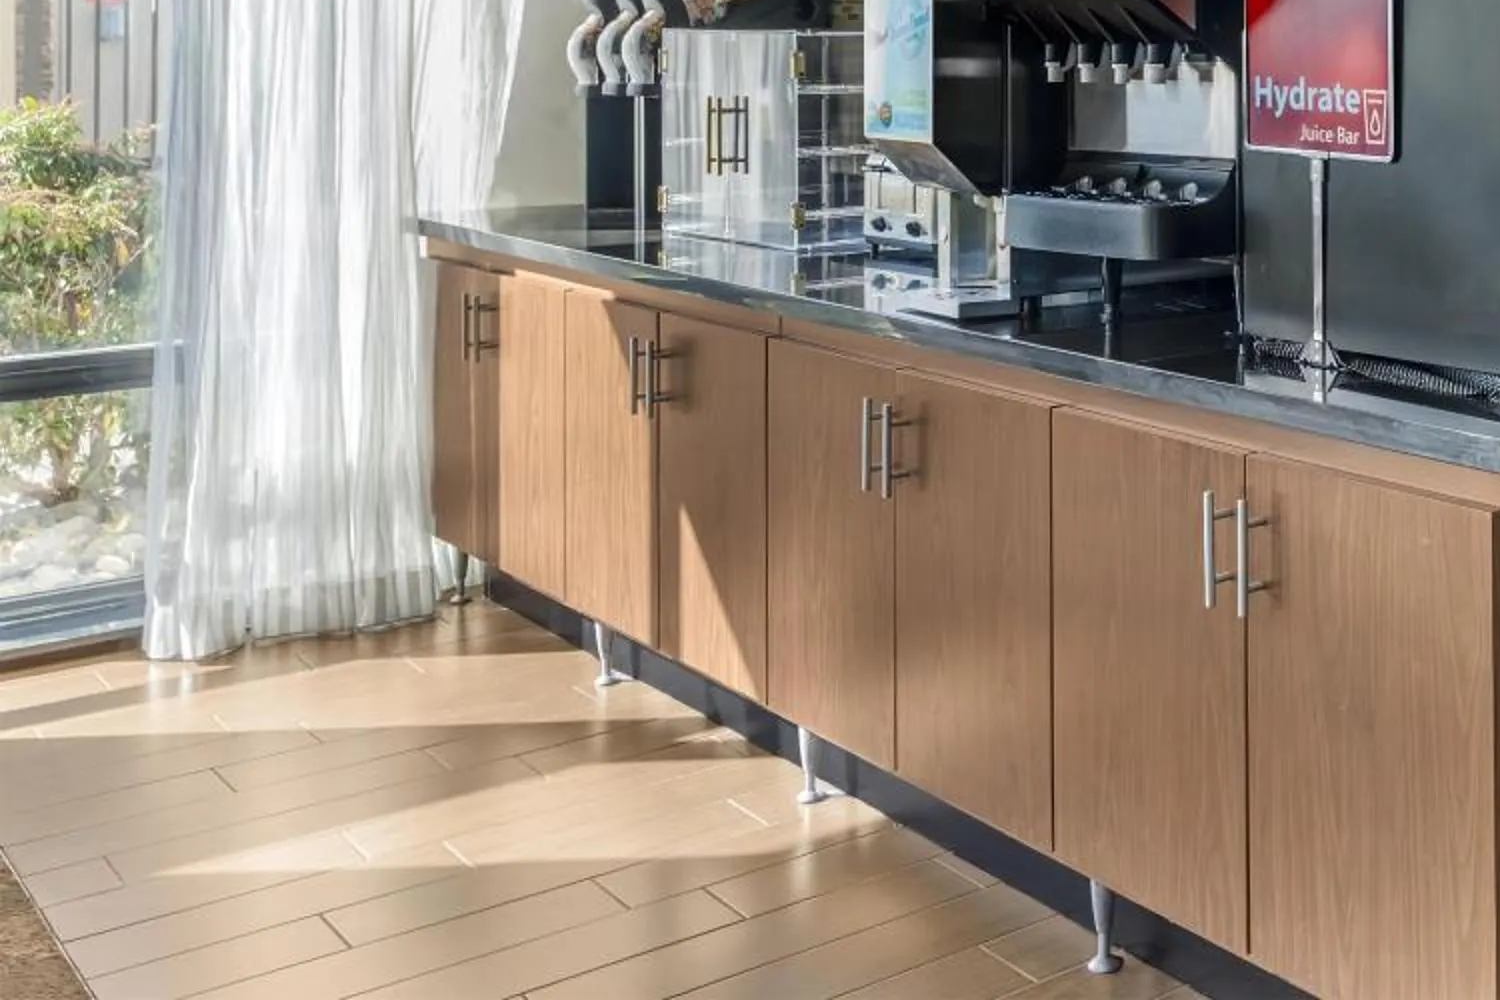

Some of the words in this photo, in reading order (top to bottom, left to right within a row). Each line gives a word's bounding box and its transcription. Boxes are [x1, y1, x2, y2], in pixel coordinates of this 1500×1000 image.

[1254, 74, 1361, 118] Hydrate
[1299, 123, 1333, 144] Juice
[1336, 125, 1360, 145] Bar
